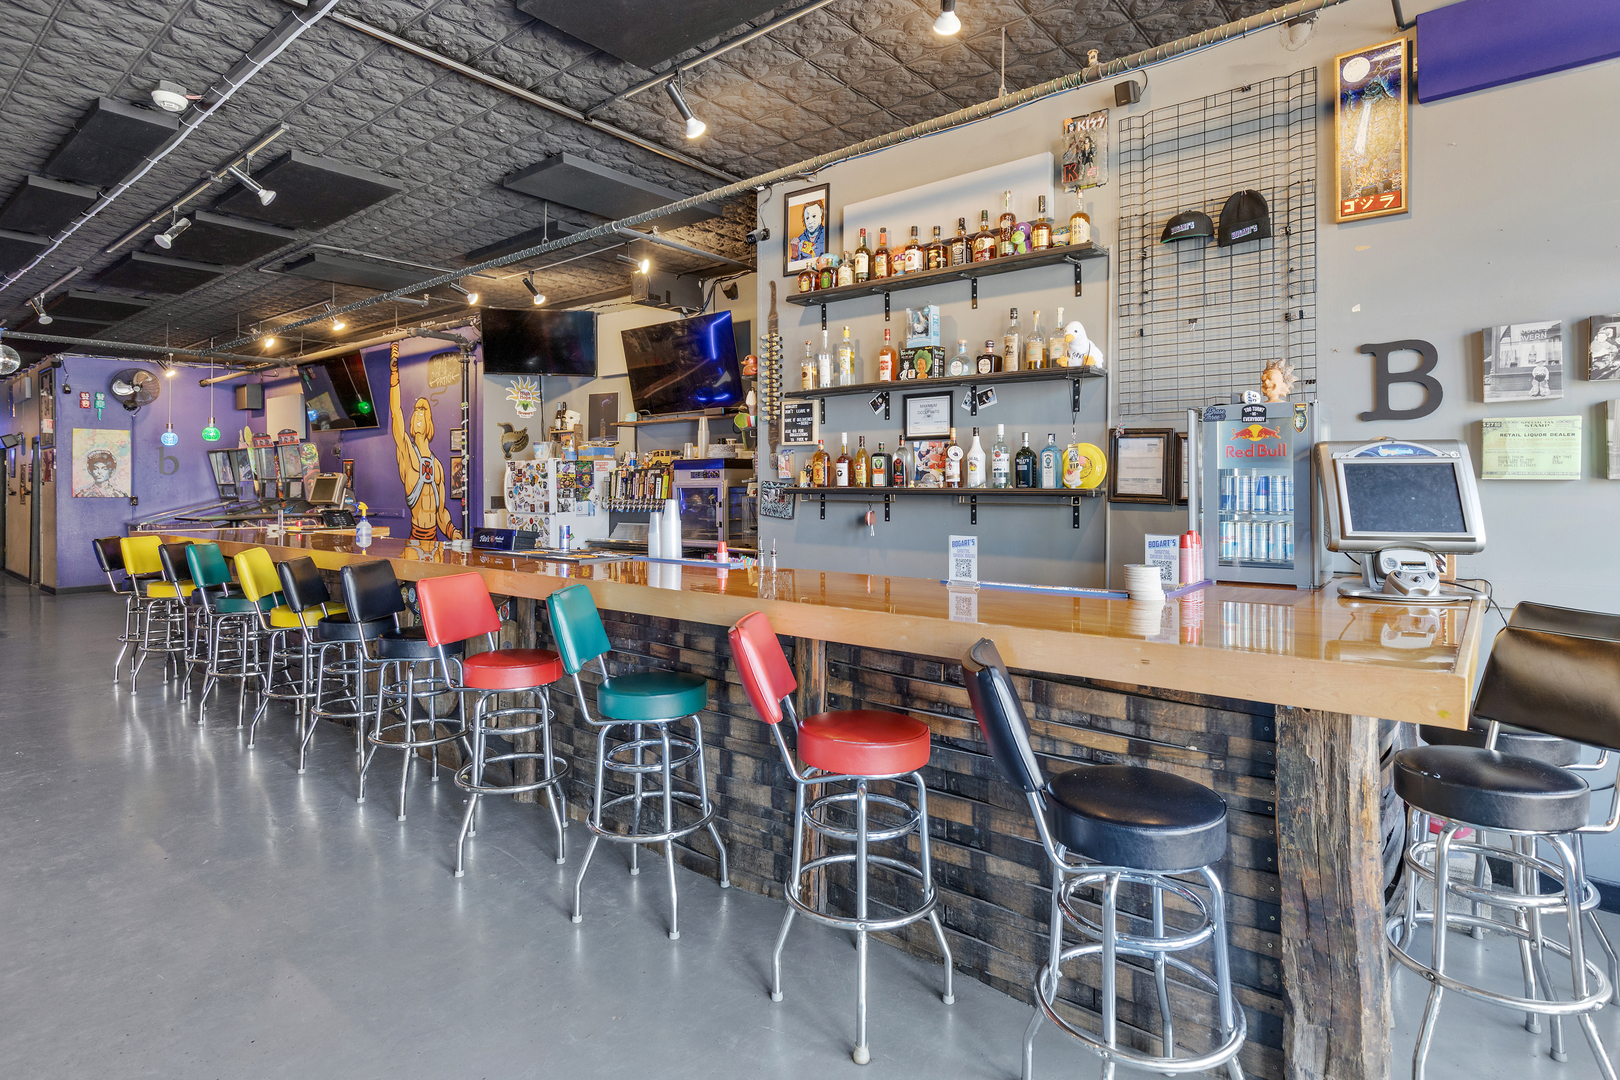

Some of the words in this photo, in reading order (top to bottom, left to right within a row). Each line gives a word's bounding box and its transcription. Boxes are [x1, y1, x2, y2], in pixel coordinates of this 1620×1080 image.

[1077, 115, 1107, 133] KISS
[1064, 163, 1079, 183] K
[1344, 194, 1396, 213] ゴジラ
[1357, 339, 1443, 421] B
[1225, 444, 1255, 458] Red
[1257, 443, 1287, 457] Bull
[156, 446, 180, 475] b
[952, 539, 977, 548] BOGART'S
[1148, 539, 1177, 549] BOGART'S
